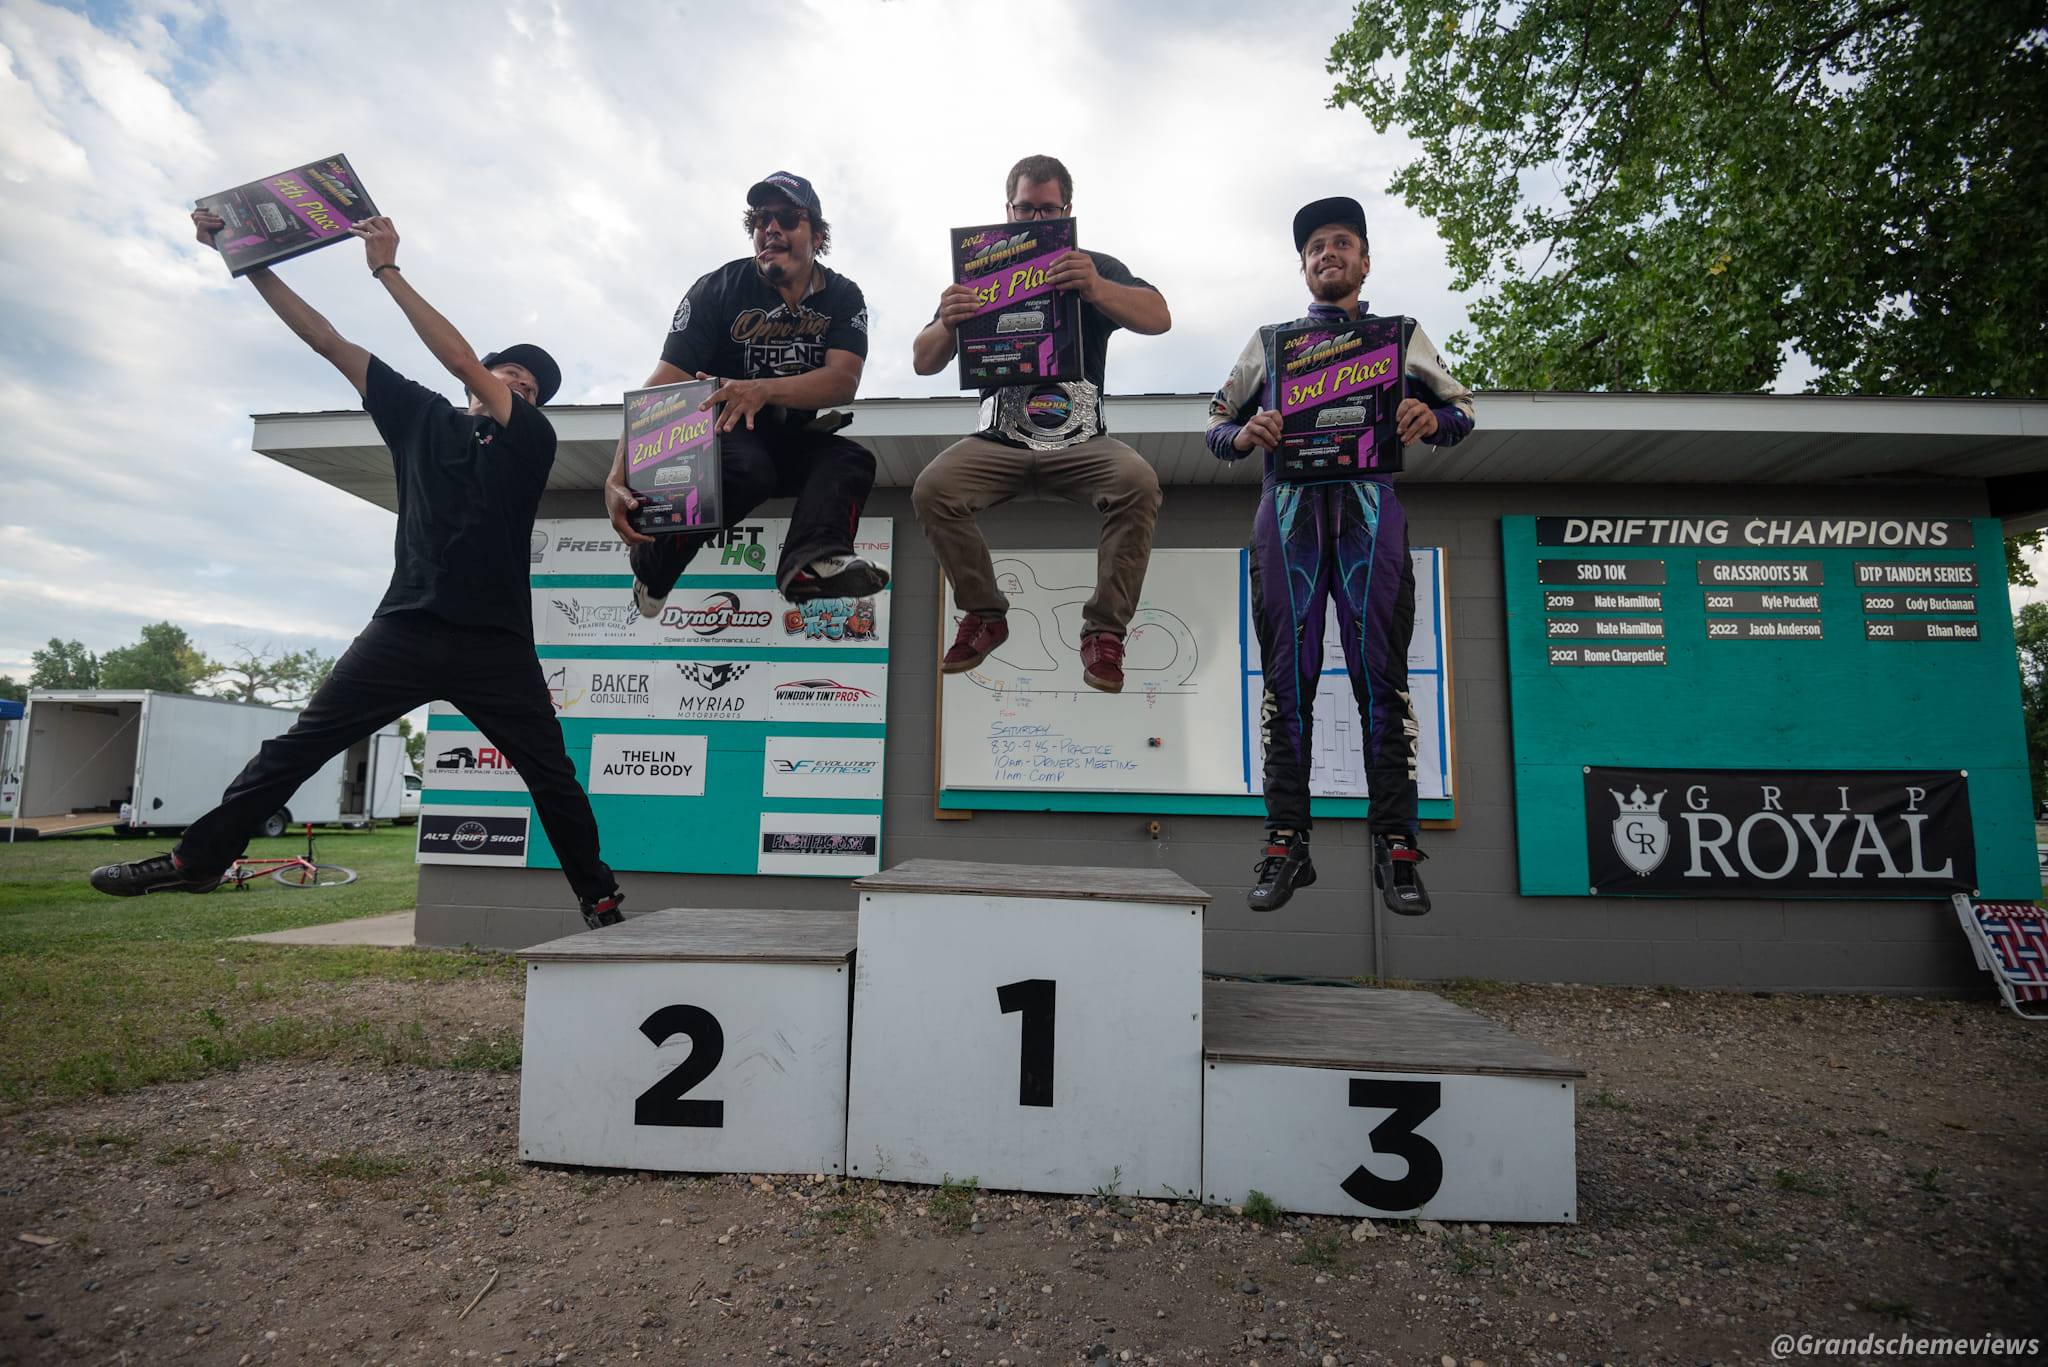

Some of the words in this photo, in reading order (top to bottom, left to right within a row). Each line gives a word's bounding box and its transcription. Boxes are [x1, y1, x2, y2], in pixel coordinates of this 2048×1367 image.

[272, 178, 309, 200] 4th
[296, 200, 340, 231] Place
[960, 233, 985, 249] 2022
[965, 256, 989, 272] DRIFT
[990, 239, 1037, 263] CHALLENGE
[1007, 266, 1049, 298] Pla
[1284, 334, 1309, 350] 2022
[1287, 356, 1312, 371] DRIFT
[1313, 338, 1362, 362] CHALLENGE
[1287, 371, 1328, 405] 3rd
[1333, 357, 1391, 392] Place
[632, 430, 663, 465] 2nd
[668, 418, 709, 454] Place
[700, 527, 764, 549] IFT
[1563, 520, 1729, 544] DRIFTING
[1744, 520, 1949, 546] CHAMPIONS
[556, 541, 631, 552] PREST
[1577, 565, 1601, 580] SRD
[1604, 565, 1627, 580] 10K
[1713, 565, 1790, 581] GRASSROOTS
[1792, 566, 1808, 581] 5K
[1860, 567, 1882, 582] DTP
[1885, 567, 1931, 582] TANDEM
[1933, 567, 1973, 583] SERIES
[1548, 596, 1574, 607] 2019
[1594, 596, 1617, 608] Nate
[1618, 596, 1661, 608] Hamilton
[1708, 597, 1733, 607] 2021
[1762, 595, 1782, 609] Kyle
[1784, 595, 1818, 608] Puckett
[1866, 598, 1894, 608] 2020
[1906, 597, 1928, 612] Cody
[1930, 598, 1974, 610] Buchanan
[580, 606, 627, 623] PGT
[660, 606, 772, 629] DynoTune
[578, 622, 606, 631] PRAIRIE
[606, 622, 627, 631] GOLD
[1549, 623, 1579, 634] 2020
[1597, 622, 1619, 634] Nate
[1620, 622, 1662, 635] Hamilton
[1710, 624, 1738, 635] 2022
[1749, 623, 1776, 636] Jacob
[1777, 623, 1821, 636] Anderson
[1869, 626, 1894, 636] 2021
[1927, 624, 1953, 637] Ethan
[1954, 625, 1978, 637] Reed
[664, 636, 686, 645] Speed
[1552, 650, 1577, 661] 2021
[1584, 650, 1611, 662] Rome
[1611, 650, 1664, 664] Charpentier
[592, 674, 650, 693] BAKER
[590, 693, 650, 704] CONSULTING
[776, 690, 815, 701] WINDOW
[679, 697, 745, 711] MYRIAD
[622, 750, 675, 763] THELIN
[603, 764, 645, 776] AUTO
[650, 765, 693, 776] BODY
[811, 766, 872, 774] FITNESS
[1686, 785, 1926, 811] GRIP
[423, 832, 450, 841] AL'S
[452, 834, 488, 842] DRIFT
[490, 834, 525, 843] SHOP
[1680, 811, 1954, 880] ROYAL
[997, 979, 1057, 1107] 1
[635, 1004, 724, 1128] 2
[1339, 1078, 1443, 1211] 3
